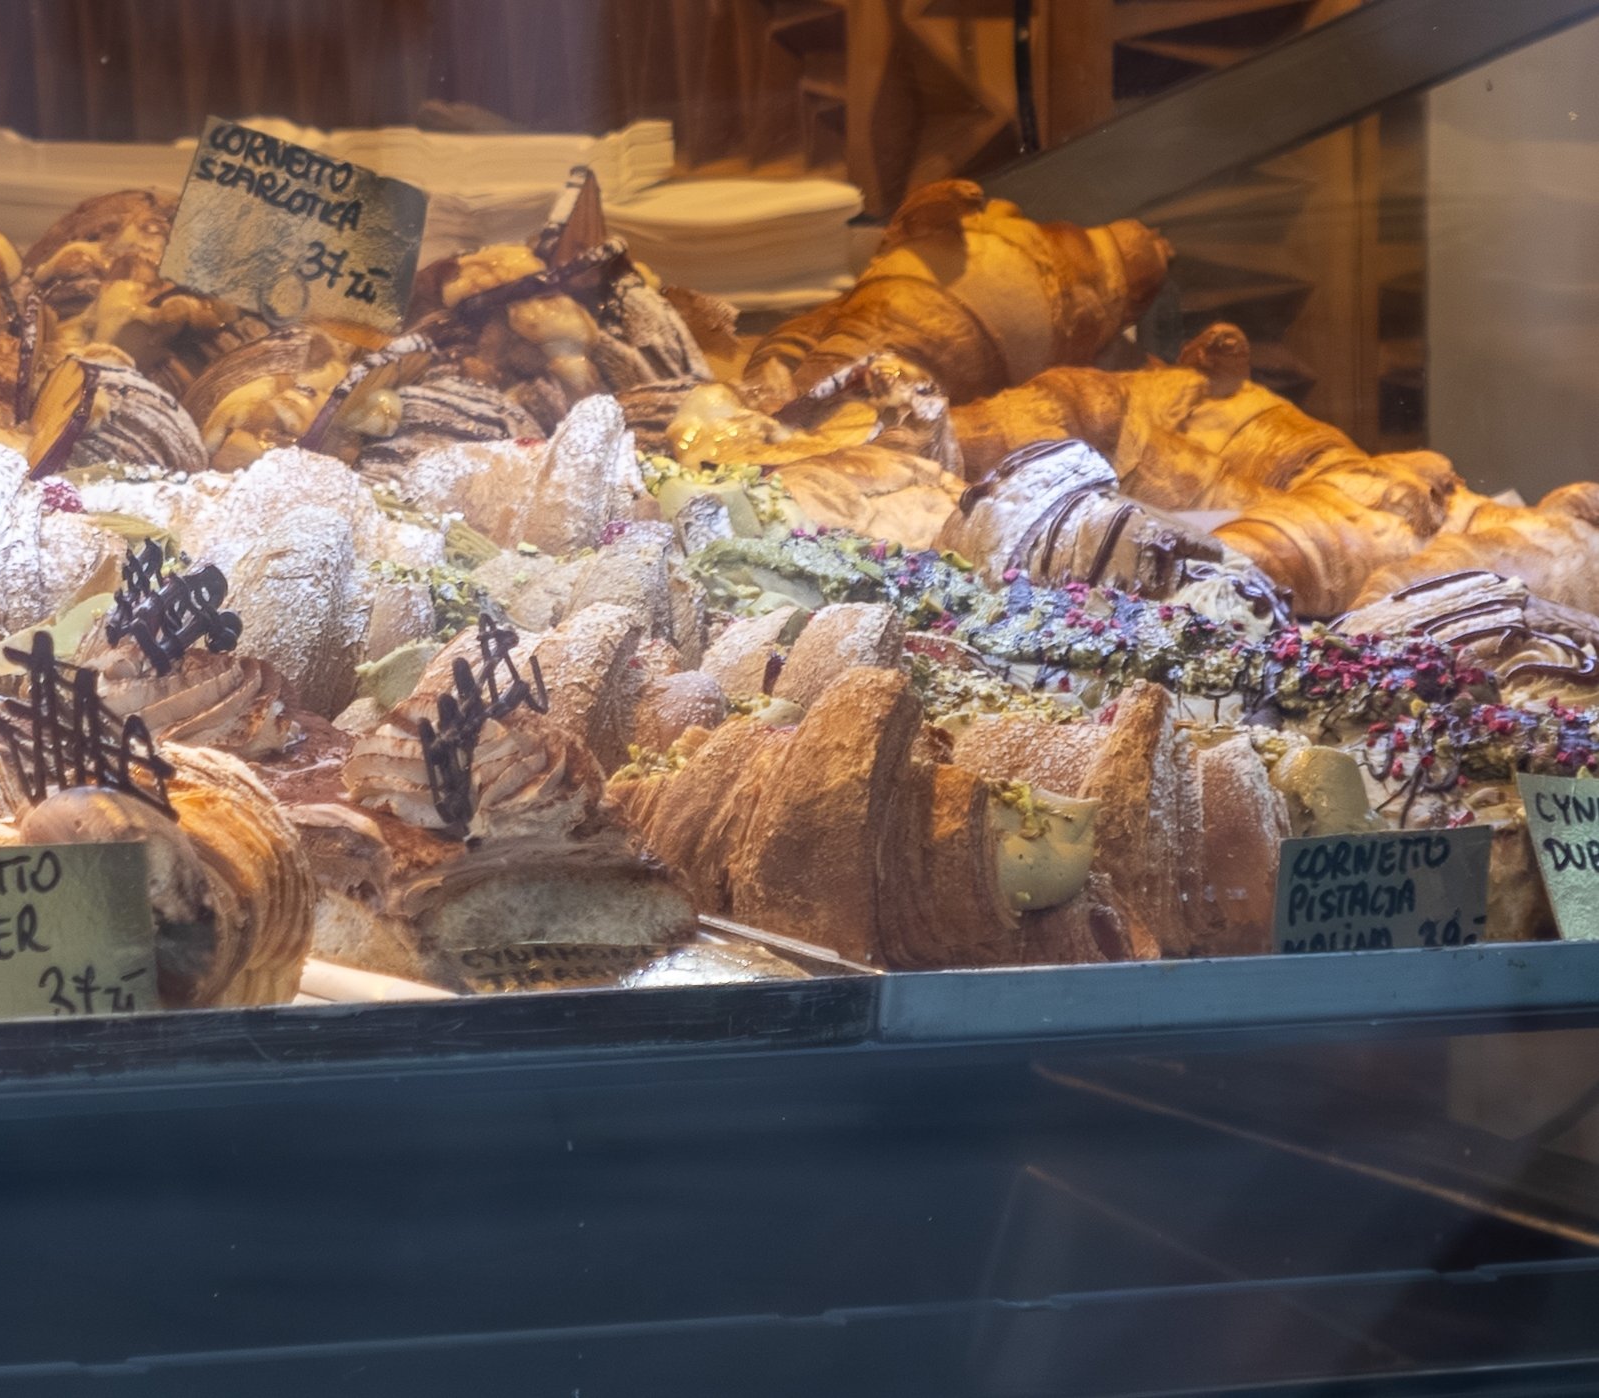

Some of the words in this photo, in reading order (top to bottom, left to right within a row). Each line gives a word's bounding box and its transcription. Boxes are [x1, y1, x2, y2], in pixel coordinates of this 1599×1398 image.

[208, 124, 354, 194] CORNETTO
[195, 157, 363, 233] SZARLOTKA
[1535, 791, 1599, 826] CYN
[1291, 836, 1450, 882] CORNETTO
[1288, 879, 1416, 927] PISTACJA
